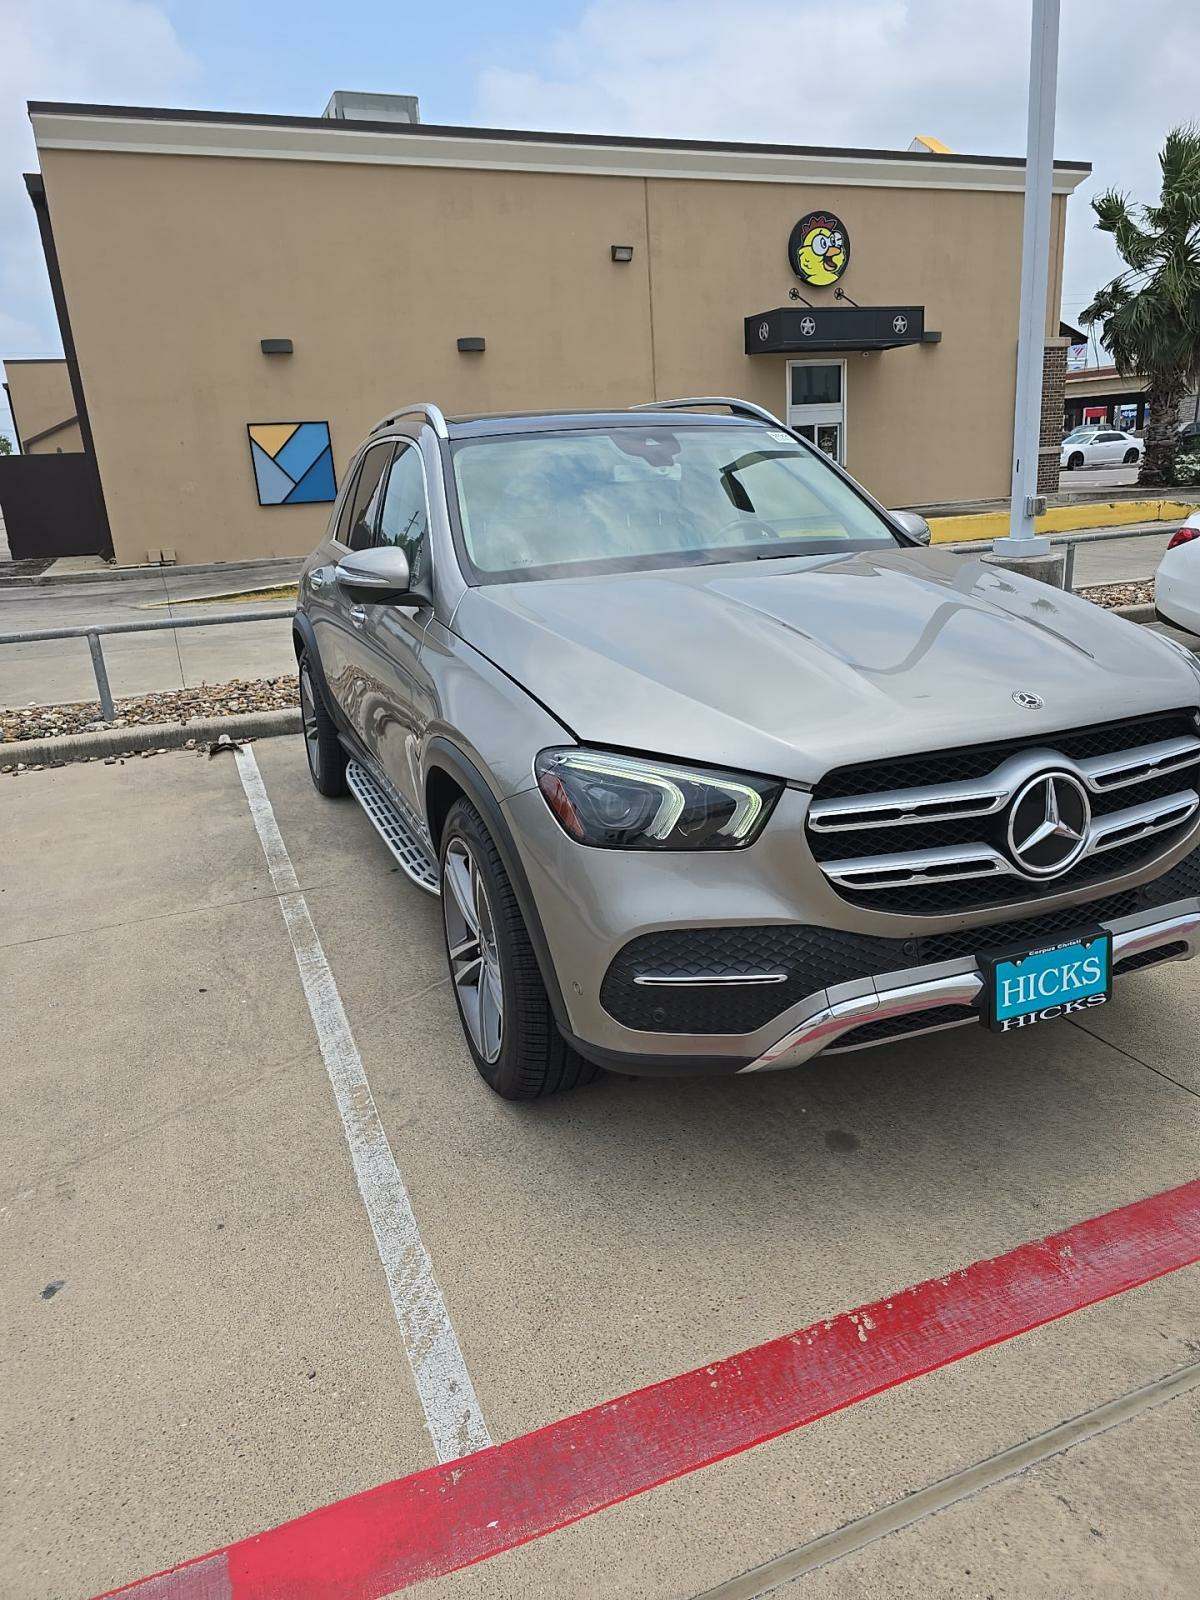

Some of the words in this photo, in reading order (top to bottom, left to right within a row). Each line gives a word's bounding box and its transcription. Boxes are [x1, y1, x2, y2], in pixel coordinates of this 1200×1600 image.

[1029, 946, 1056, 956] Corpus
[1002, 956, 1101, 1007] HICKS
[1001, 993, 1107, 1032] HICKS
